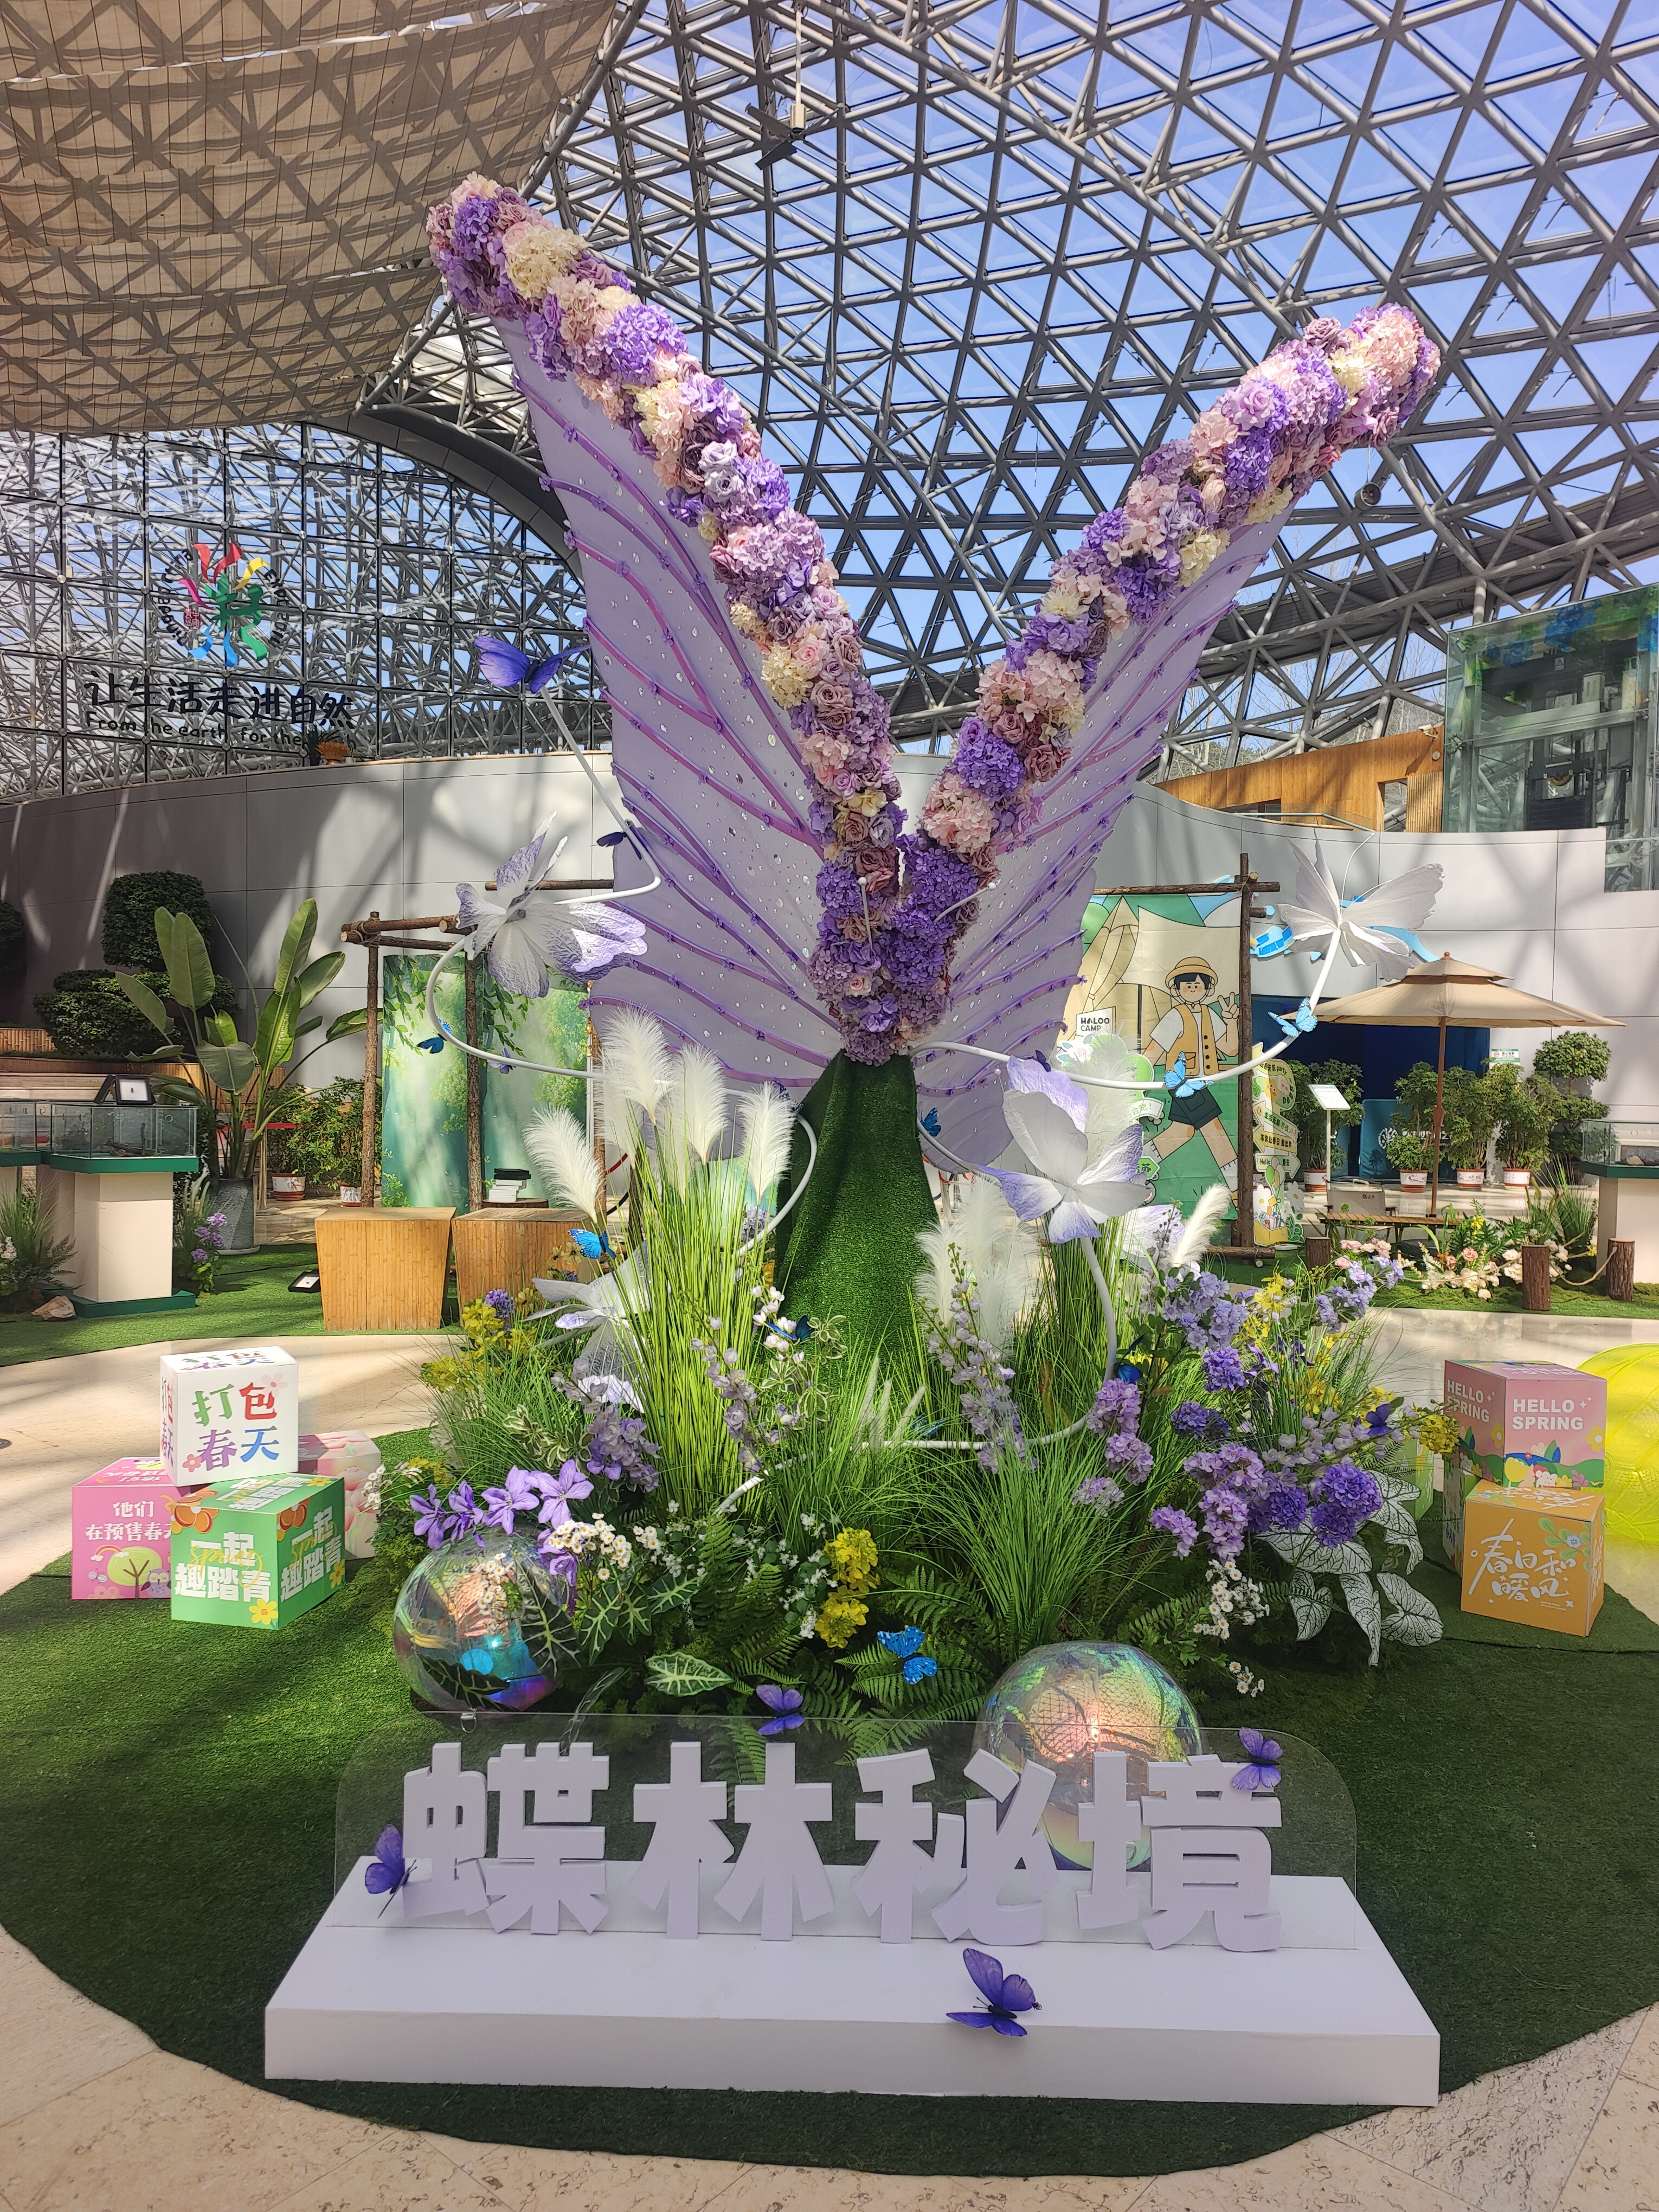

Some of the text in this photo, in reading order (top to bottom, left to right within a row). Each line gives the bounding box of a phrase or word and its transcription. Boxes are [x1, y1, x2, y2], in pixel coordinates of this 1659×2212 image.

[84, 671, 355, 730] 让生活走进自然
[86, 711, 136, 731] From
[179, 724, 227, 741] earth
[241, 727, 267, 743] for
[273, 728, 303, 745] the
[192, 1382, 277, 1427] 打包
[1447, 1379, 1484, 1404] HELLO
[1513, 1399, 1575, 1413] HELLO
[1447, 1396, 1489, 1423] SPRING
[1512, 1416, 1583, 1430] SPRING
[197, 1426, 280, 1471] 春天
[113, 1501, 155, 1518] 他们
[292, 1506, 333, 1546] 一起
[191, 1532, 256, 1566] 一起
[175, 1562, 272, 1603] 趣踏青
[280, 1534, 342, 1603] 趣踏青
[1491, 1572, 1570, 1602] 暖风
[403, 1741, 1282, 1952] 蝶林秘境
